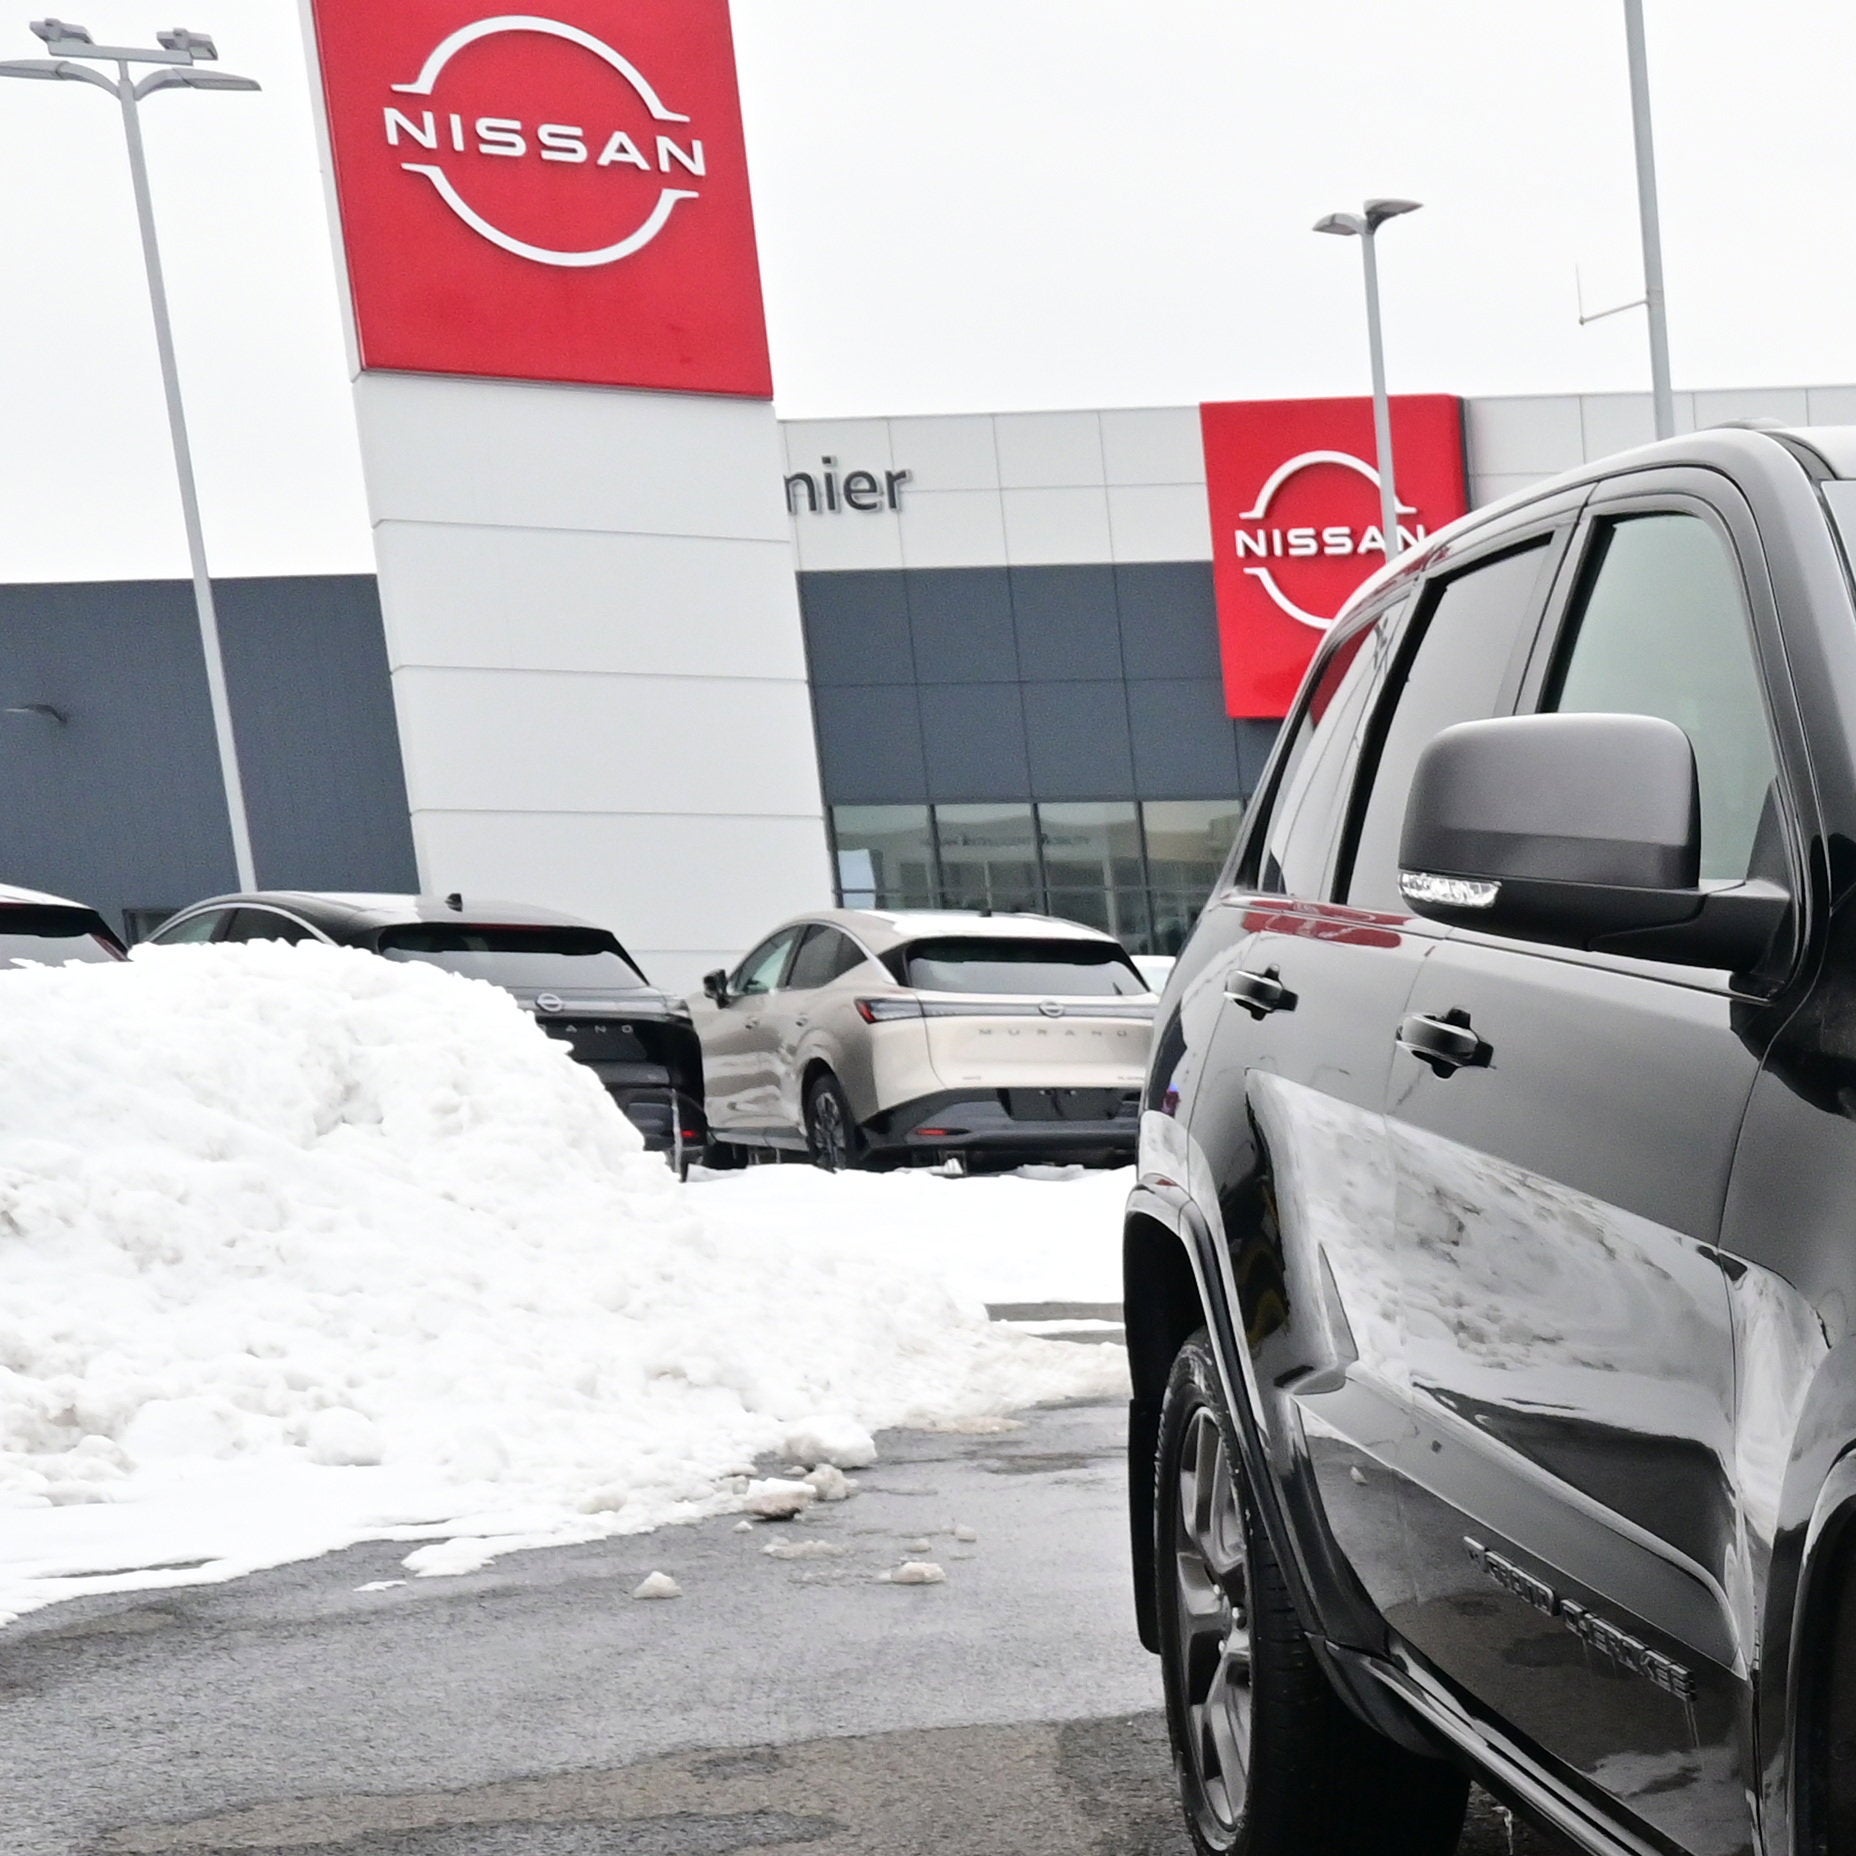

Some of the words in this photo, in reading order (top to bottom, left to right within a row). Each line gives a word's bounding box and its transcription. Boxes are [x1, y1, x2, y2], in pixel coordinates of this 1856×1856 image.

[383, 106, 706, 176] NISSAN
[783, 455, 911, 514] nier
[1234, 524, 1427, 557] NISSAN
[978, 1027, 1128, 1039] MURANO
